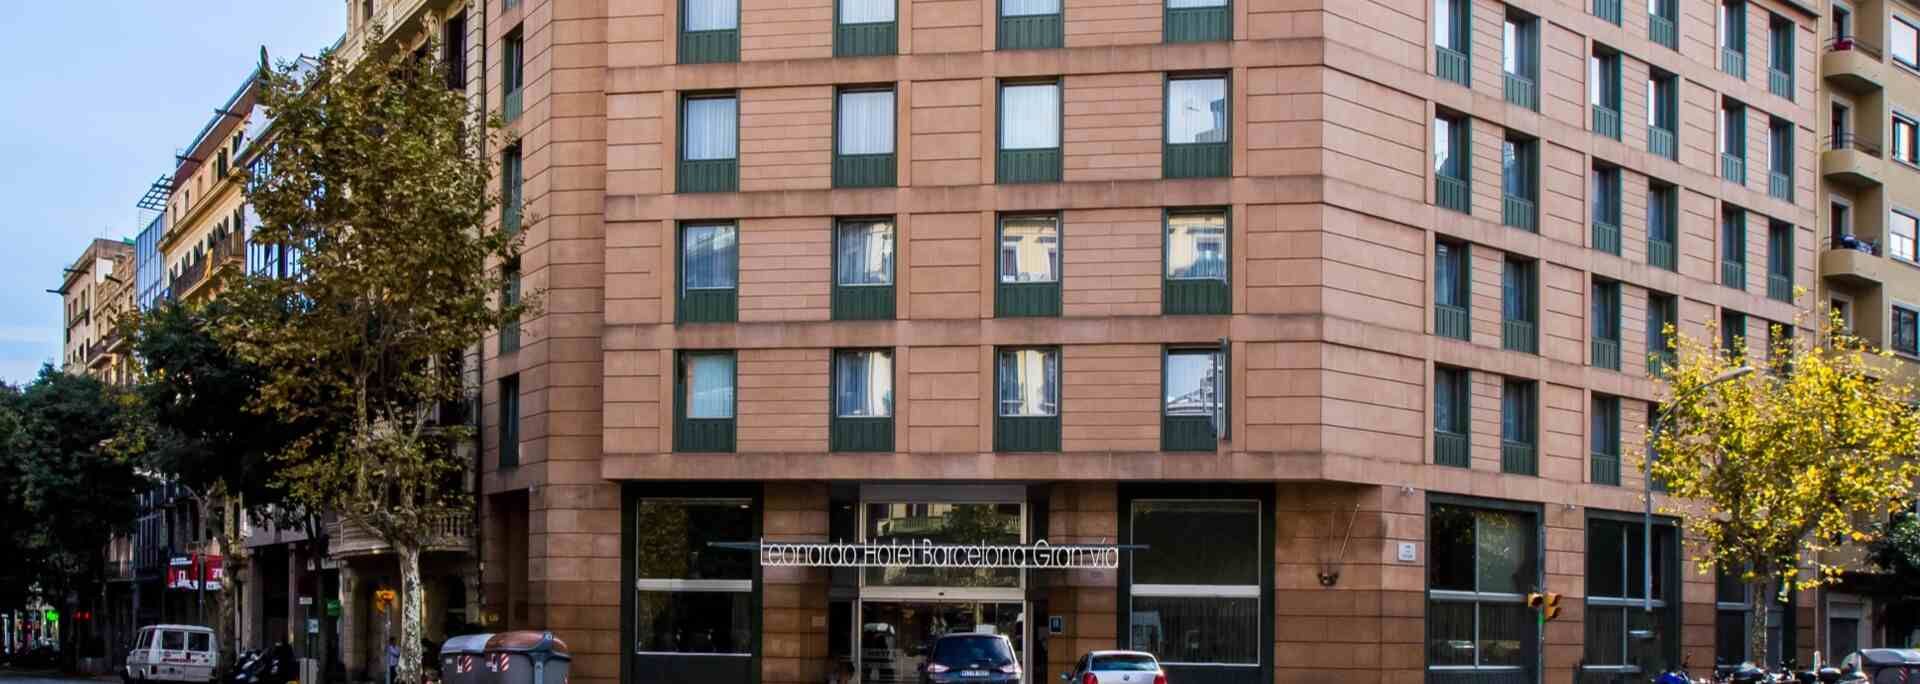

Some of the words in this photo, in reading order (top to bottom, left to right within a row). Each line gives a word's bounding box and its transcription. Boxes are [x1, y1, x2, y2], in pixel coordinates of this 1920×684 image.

[760, 537, 857, 567] Leonardo
[864, 538, 915, 567] Hotel
[922, 538, 1026, 568] Barcelona
[1033, 538, 1083, 568] Gran
